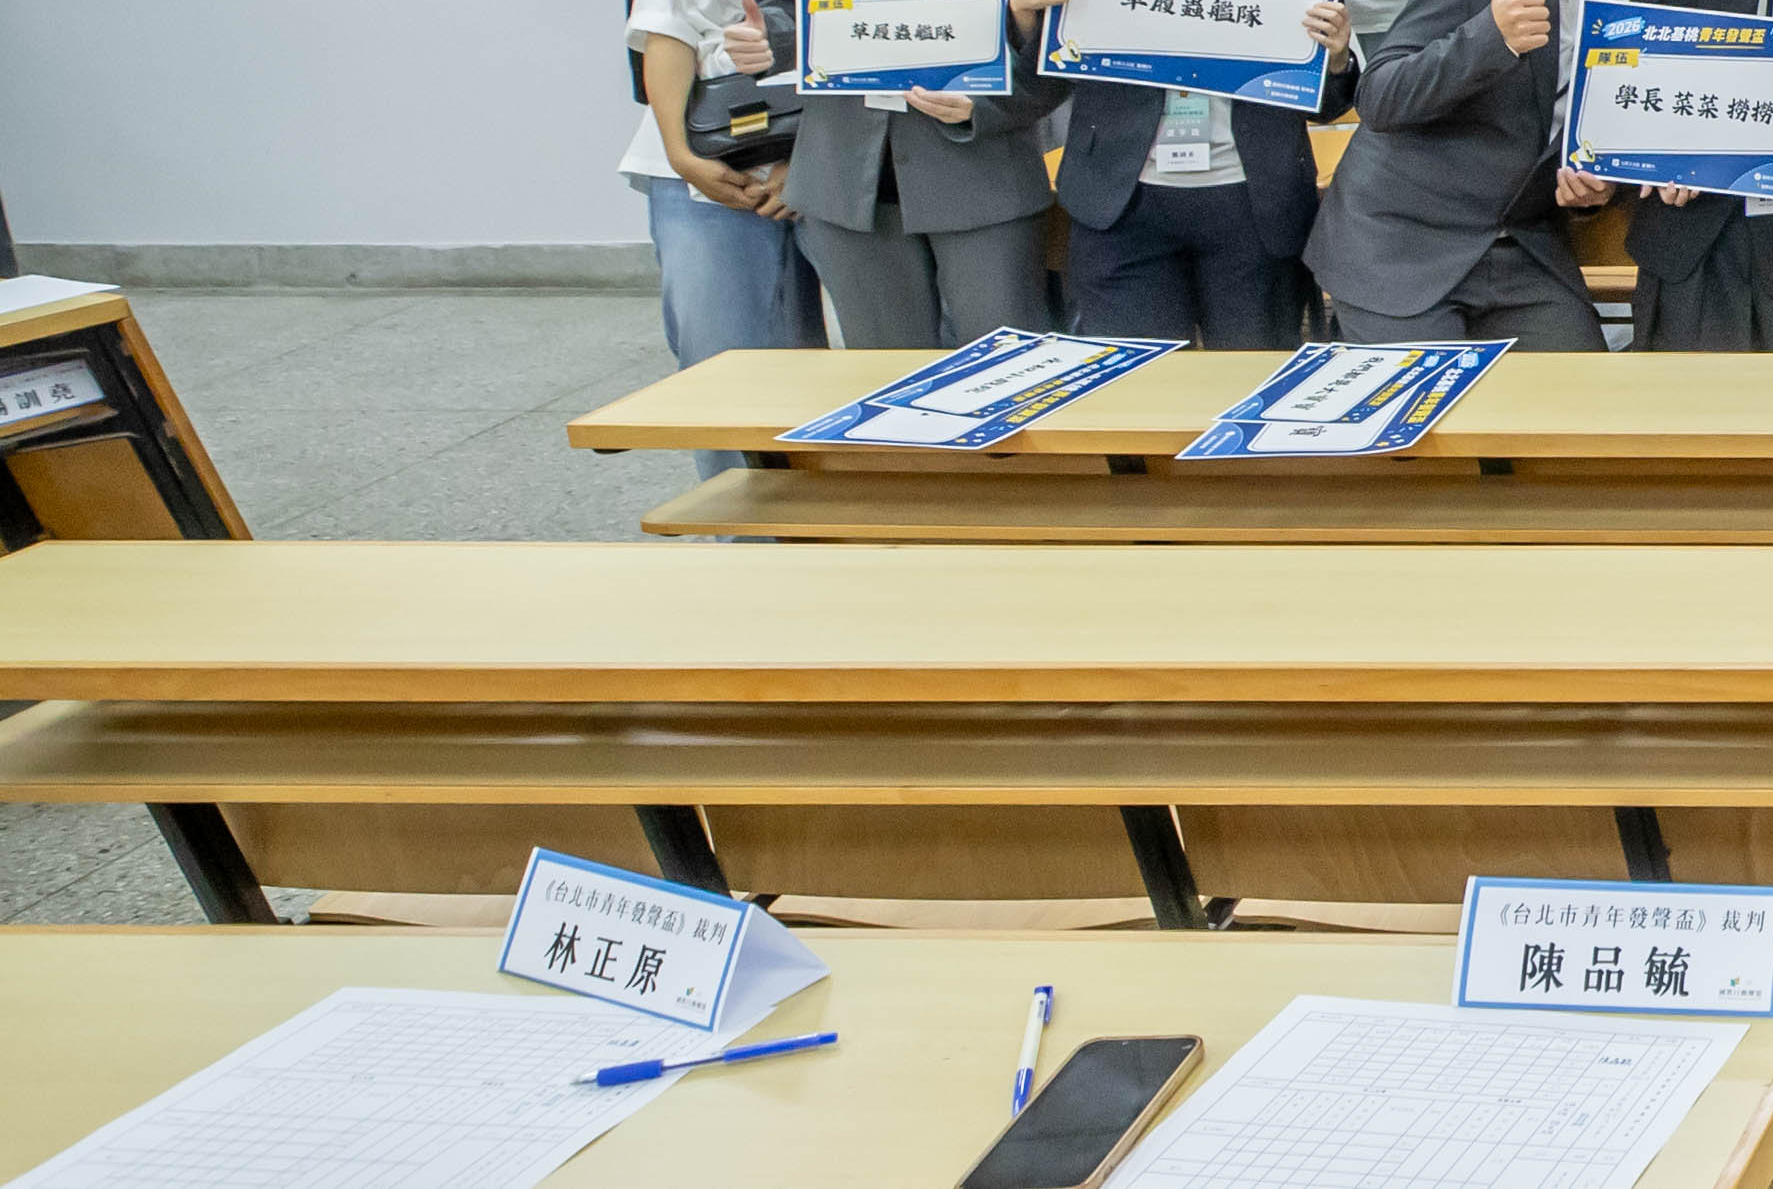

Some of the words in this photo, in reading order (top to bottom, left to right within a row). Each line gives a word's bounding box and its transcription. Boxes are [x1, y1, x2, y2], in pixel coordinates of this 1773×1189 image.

[850, 21, 957, 42] 草履蟲艦隊
[1606, 20, 1643, 37] 2026
[1642, 25, 1767, 44] 北北基桃青年發聲盃
[1597, 51, 1629, 66] 隊伍
[1615, 84, 1665, 113] 學長
[1672, 91, 1720, 120] 菜菜
[692, 917, 728, 947] 裁判
[1720, 909, 1766, 934] 裁判
[543, 921, 668, 996] 林正原
[1518, 942, 1692, 998] 陳品毓
